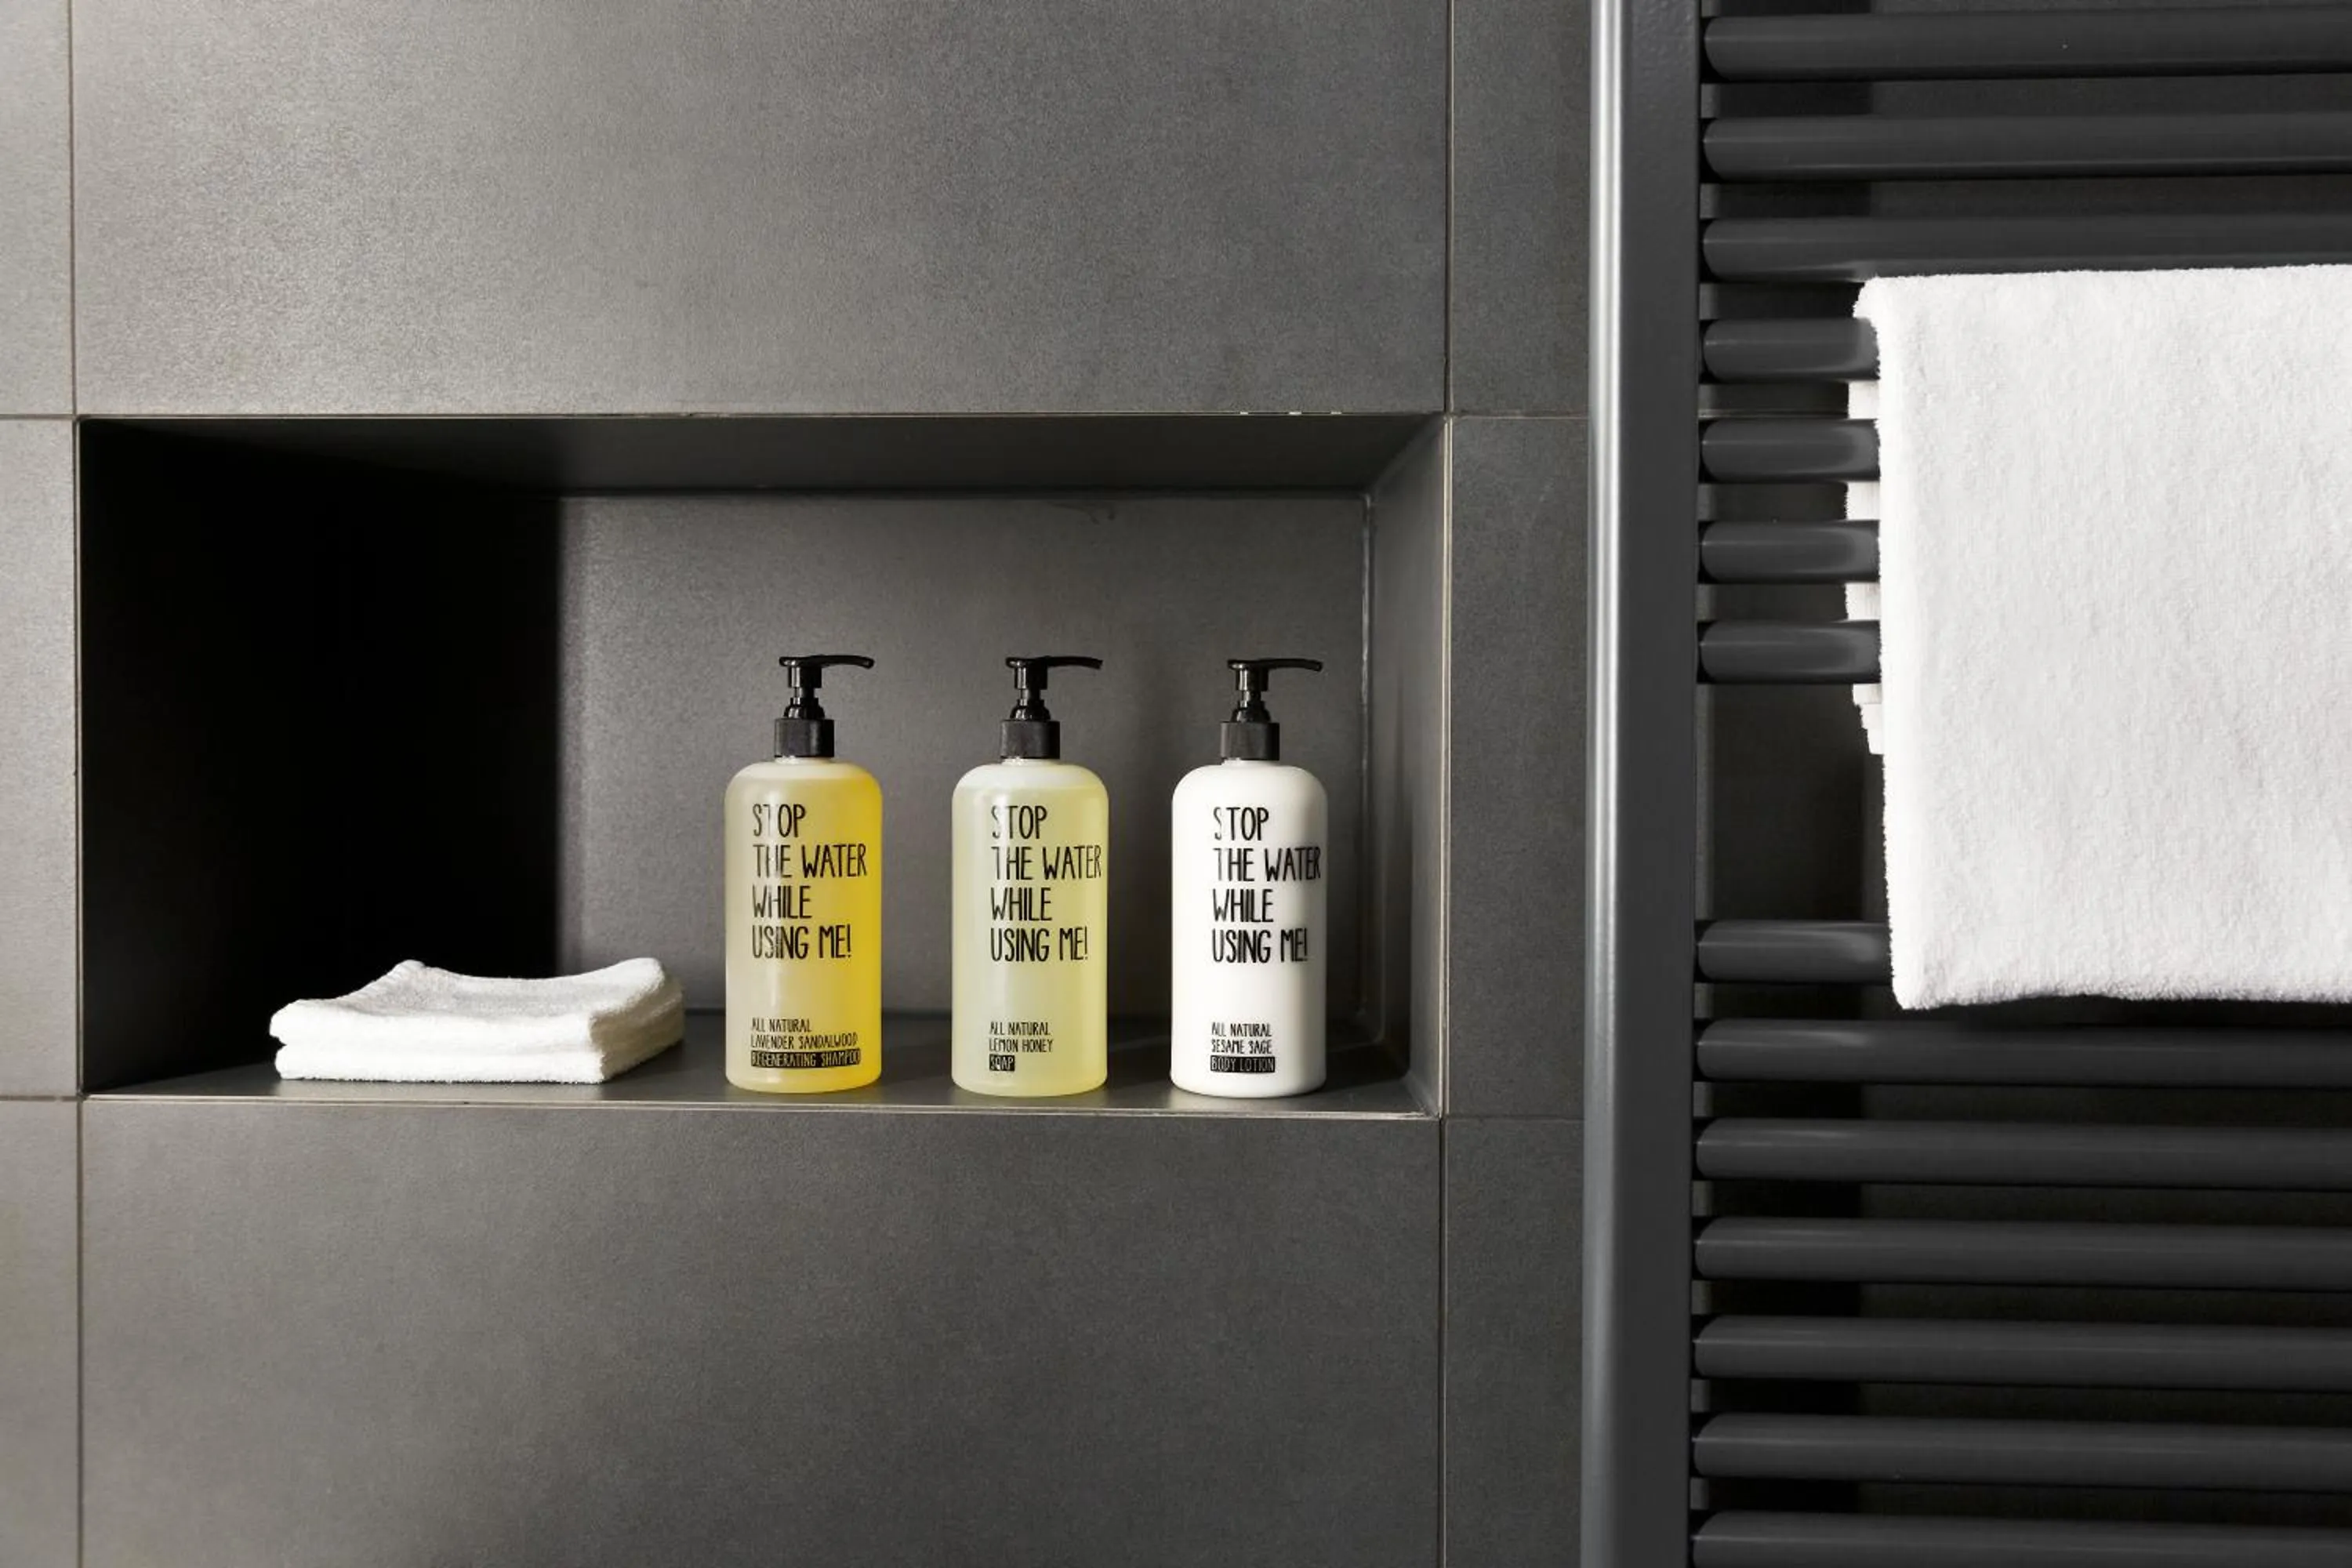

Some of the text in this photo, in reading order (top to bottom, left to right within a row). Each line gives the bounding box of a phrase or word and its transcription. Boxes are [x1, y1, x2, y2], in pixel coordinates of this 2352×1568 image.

[991, 805, 1047, 839] STOP
[1213, 807, 1269, 840] STOP
[753, 844, 867, 878] THE WATER
[991, 844, 1102, 880] THE WATER
[1213, 846, 1321, 881] THE WATER
[753, 885, 811, 919] WHILE
[990, 887, 1052, 921] WHILE
[1213, 888, 1274, 923] WHILE
[753, 924, 851, 960] USING ME!
[990, 926, 1088, 962] USING ME!
[1212, 927, 1308, 963] USING ME!
[750, 1032, 858, 1049] LAVENDER SANDALWOOD
[752, 1018, 811, 1033] ALL NATURAL
[989, 1022, 1051, 1036] ALL NATURAL
[1212, 1022, 1272, 1037] ALL NATURAL
[989, 1038, 1054, 1053] LEMON HONEY
[1211, 1039, 1272, 1054] SESAME SAGE
[1211, 1056, 1275, 1073] BODY LOTION
